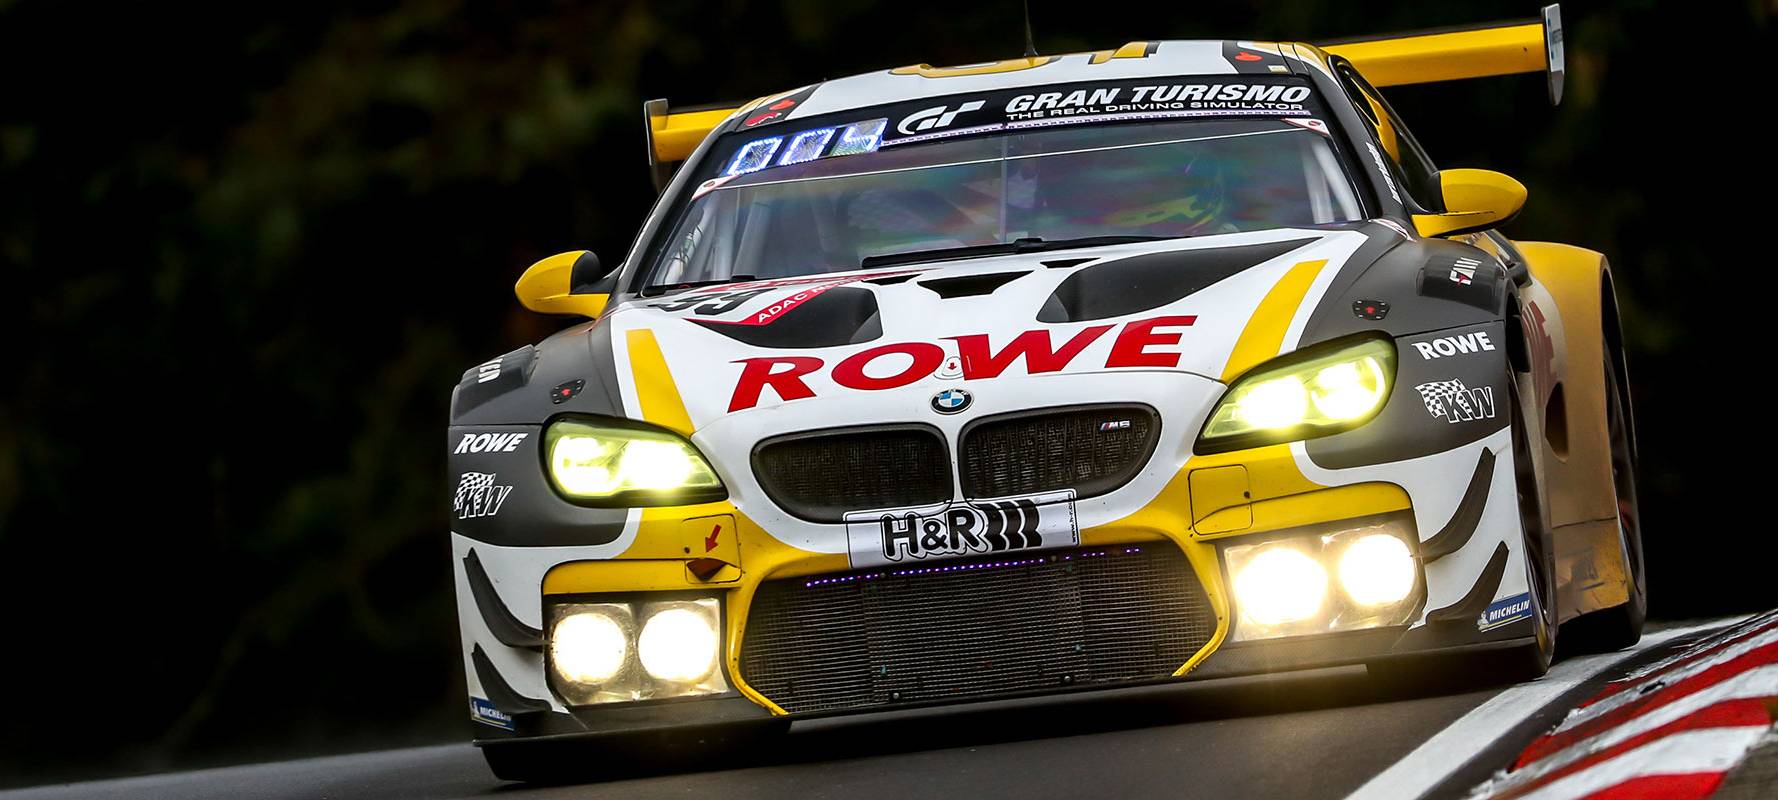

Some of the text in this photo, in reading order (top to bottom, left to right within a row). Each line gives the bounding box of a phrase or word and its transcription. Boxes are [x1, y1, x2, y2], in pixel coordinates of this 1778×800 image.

[1005, 84, 1311, 113] GRAN TURISMO
[1006, 101, 1304, 121] THE REAL DRIVING SIMULATOR
[758, 293, 808, 323] ADAC
[1411, 331, 1496, 360] ROWE
[727, 315, 1198, 414] ROWE
[1437, 386, 1496, 423] KW
[453, 432, 529, 455] ROWE
[458, 485, 514, 519] KW
[883, 507, 985, 558] H&R
[1489, 599, 1530, 621] MICHELIN
